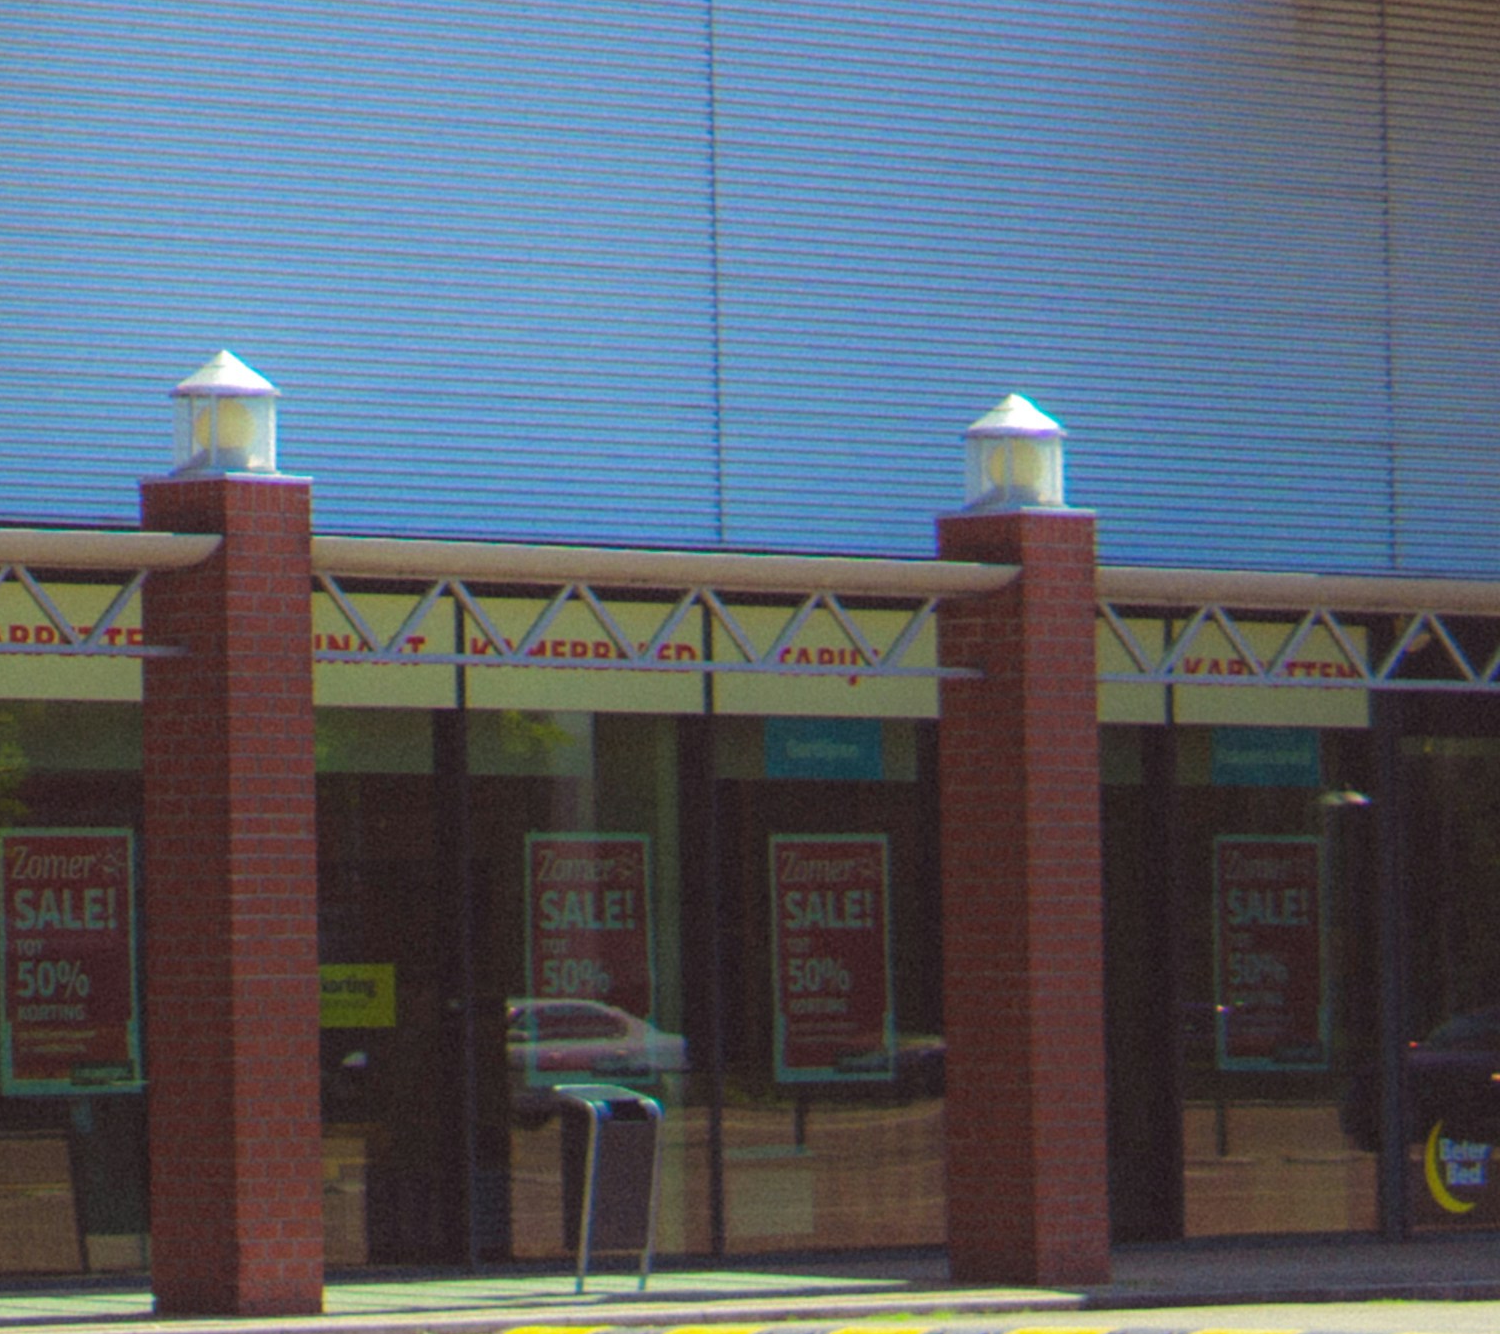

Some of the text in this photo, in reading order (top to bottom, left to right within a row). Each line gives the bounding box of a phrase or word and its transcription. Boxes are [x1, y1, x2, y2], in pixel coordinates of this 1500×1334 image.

[11, 845, 97, 880] Zomer
[538, 849, 615, 883] Zomer
[781, 850, 854, 883] Zomer
[14, 887, 117, 930] SALE!
[540, 890, 635, 930] SALE!
[785, 890, 874, 929] SALE!
[1227, 888, 1309, 925] SALE!
[16, 939, 45, 956] TOT
[17, 961, 90, 998] 50%
[543, 958, 610, 994] 50%
[788, 957, 851, 992] 50%
[1229, 952, 1289, 983] 50%
[19, 1004, 86, 1021] KORTING
[1439, 1137, 1492, 1161] Beter
[1447, 1162, 1486, 1186] Bed
